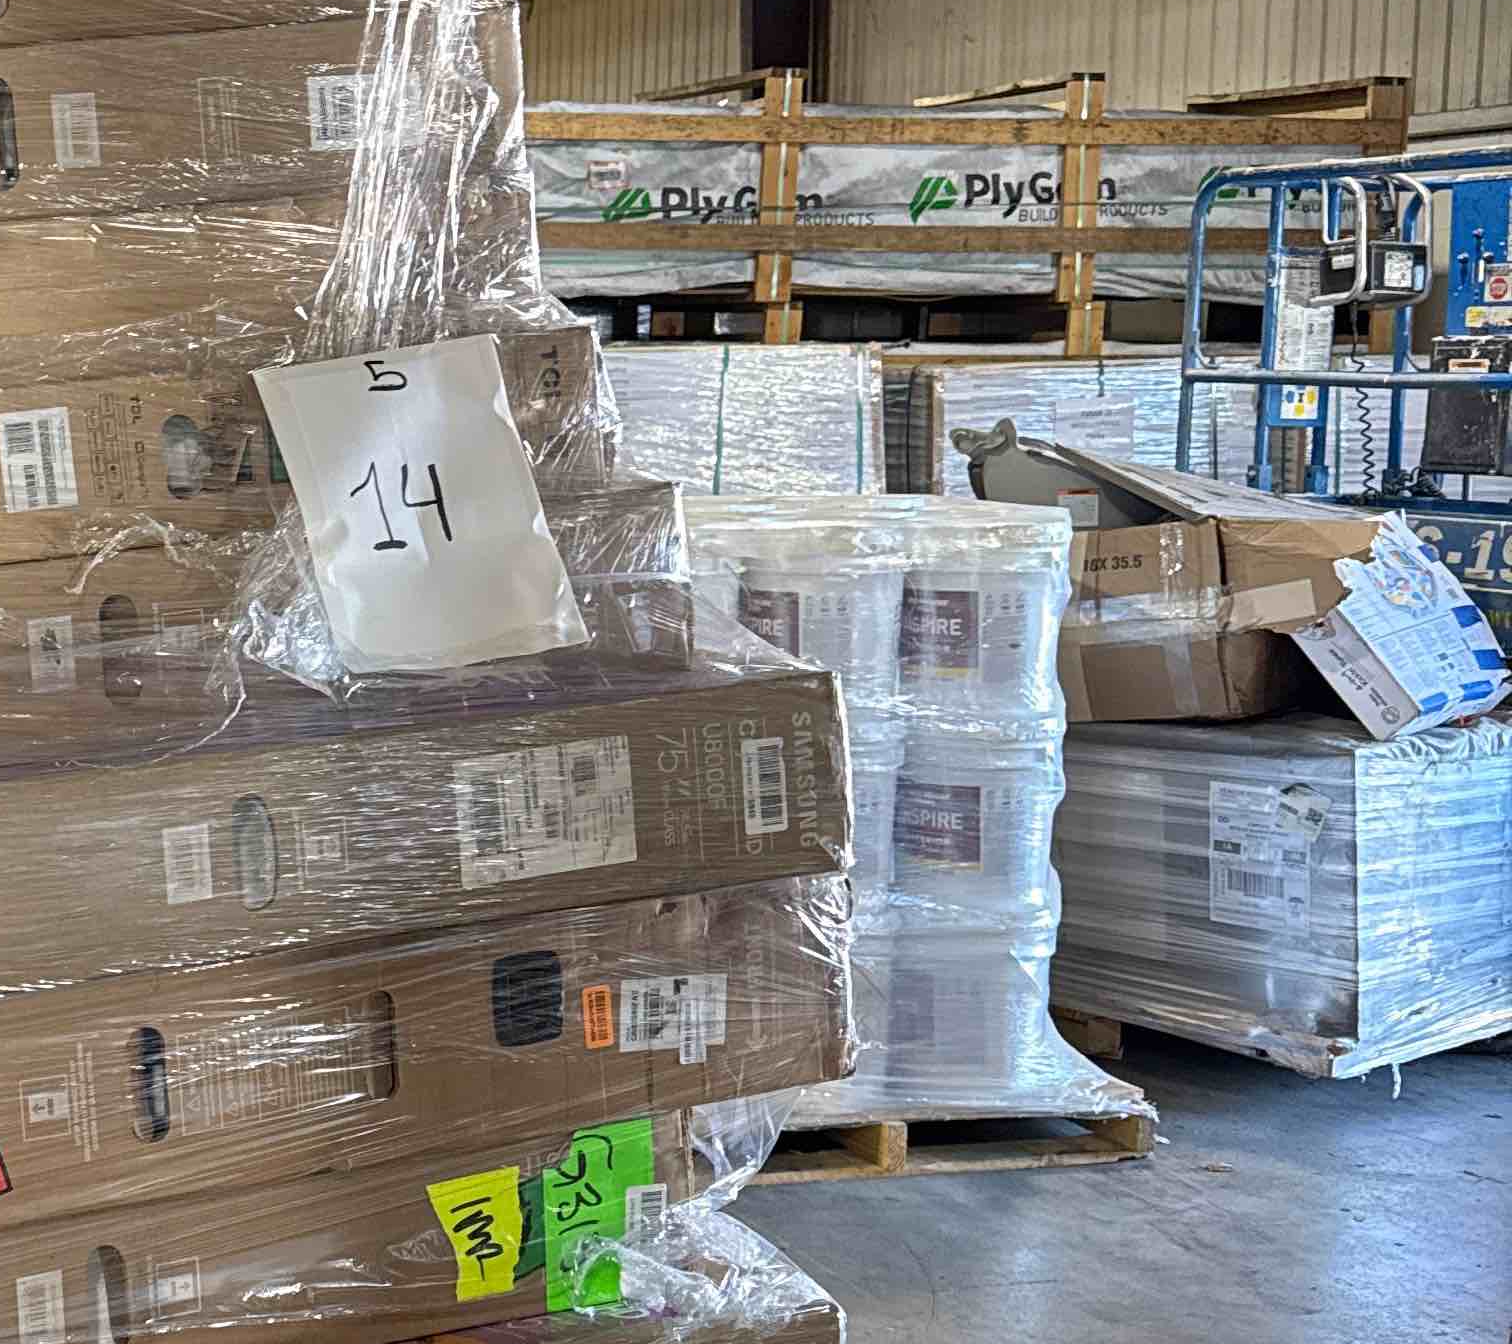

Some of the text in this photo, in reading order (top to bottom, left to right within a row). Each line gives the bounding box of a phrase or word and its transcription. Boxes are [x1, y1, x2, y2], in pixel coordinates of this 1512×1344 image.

[1099, 203, 1169, 217] RODUCTS
[366, 360, 409, 392] 5
[348, 460, 454, 550] 14
[1111, 554, 1144, 570] 35.5
[791, 711, 818, 849] SAMSUNG
